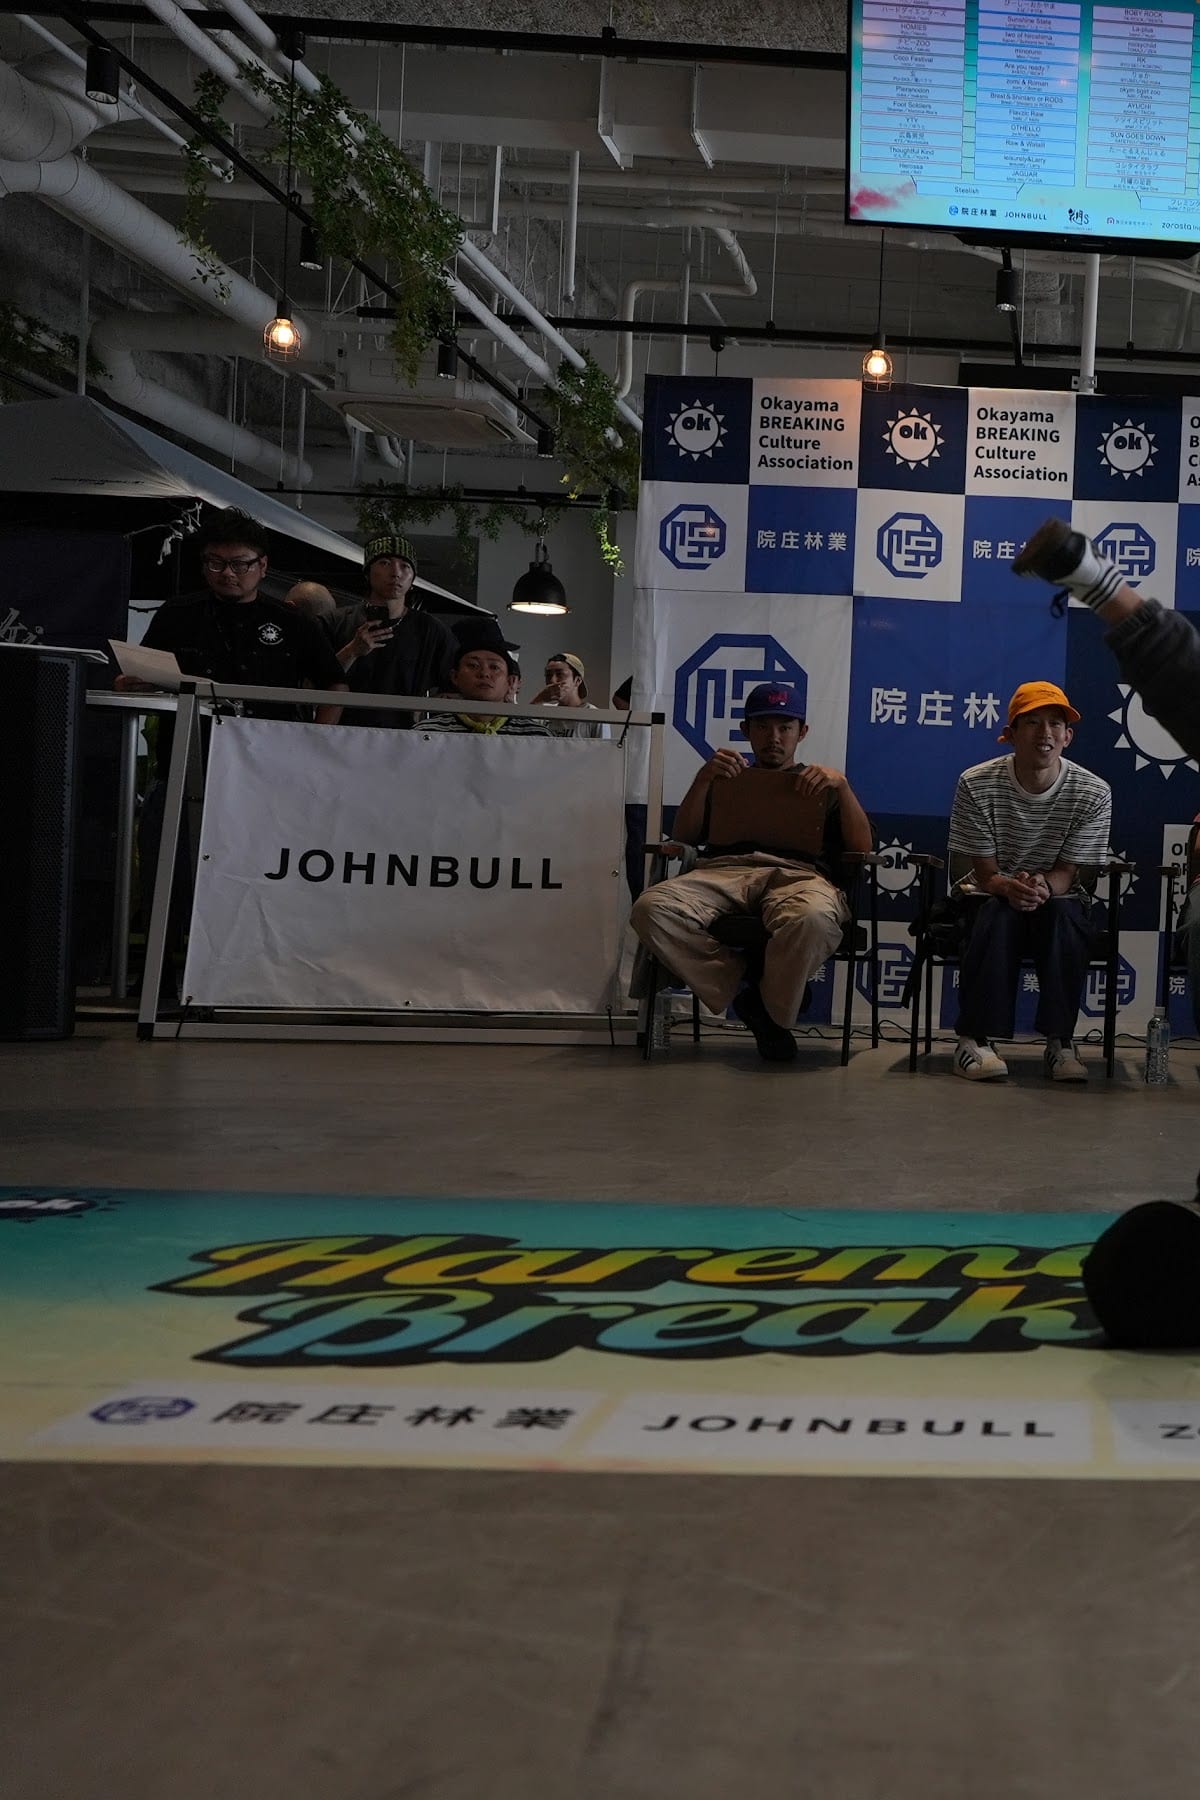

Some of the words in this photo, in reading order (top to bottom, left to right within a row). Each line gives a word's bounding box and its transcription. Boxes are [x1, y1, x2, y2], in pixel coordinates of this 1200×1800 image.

[1012, 170, 1038, 178] JAGUAR
[1004, 211, 1047, 220] JOHNBULL
[760, 396, 839, 416] Okayama
[759, 415, 845, 433] BREAKING
[976, 407, 1055, 424] Okayama
[759, 435, 821, 451] Culture
[976, 427, 1061, 444] BREAKING
[757, 454, 854, 472] Association
[975, 446, 1036, 462] Culture
[973, 465, 1069, 483] Association
[757, 529, 848, 552] 院庄林業
[972, 539, 1024, 561] 院庄
[870, 687, 1001, 729] 院庄林
[264, 847, 563, 890] JOHNBULL
[209, 1400, 577, 1430] 院庄林業
[642, 1414, 1057, 1438] JOHNBULL
